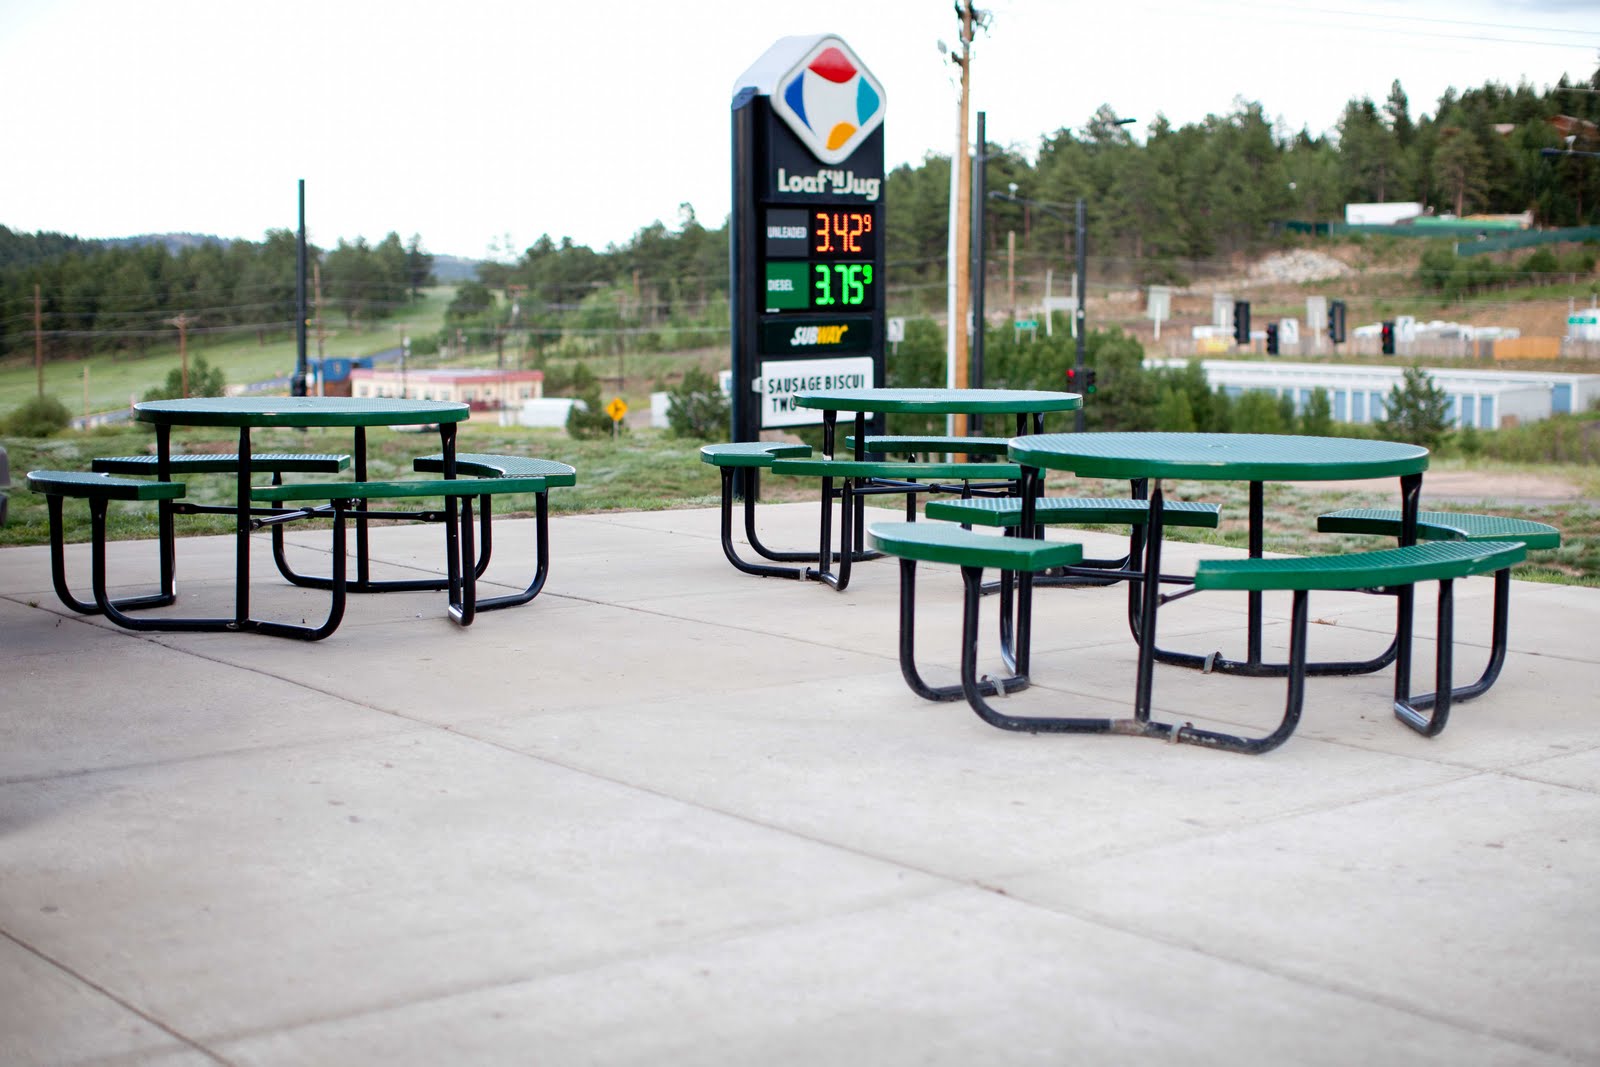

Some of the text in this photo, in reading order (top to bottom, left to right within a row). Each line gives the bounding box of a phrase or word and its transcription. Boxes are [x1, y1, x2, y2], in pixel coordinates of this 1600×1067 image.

[778, 168, 827, 193] Loaf
[833, 170, 881, 201] Jug
[767, 226, 807, 239] UNLEADED
[767, 279, 795, 291] DIESEL
[790, 324, 849, 346] SUBWAY
[768, 376, 821, 394] SAUSAGE
[772, 397, 797, 412] TWO
